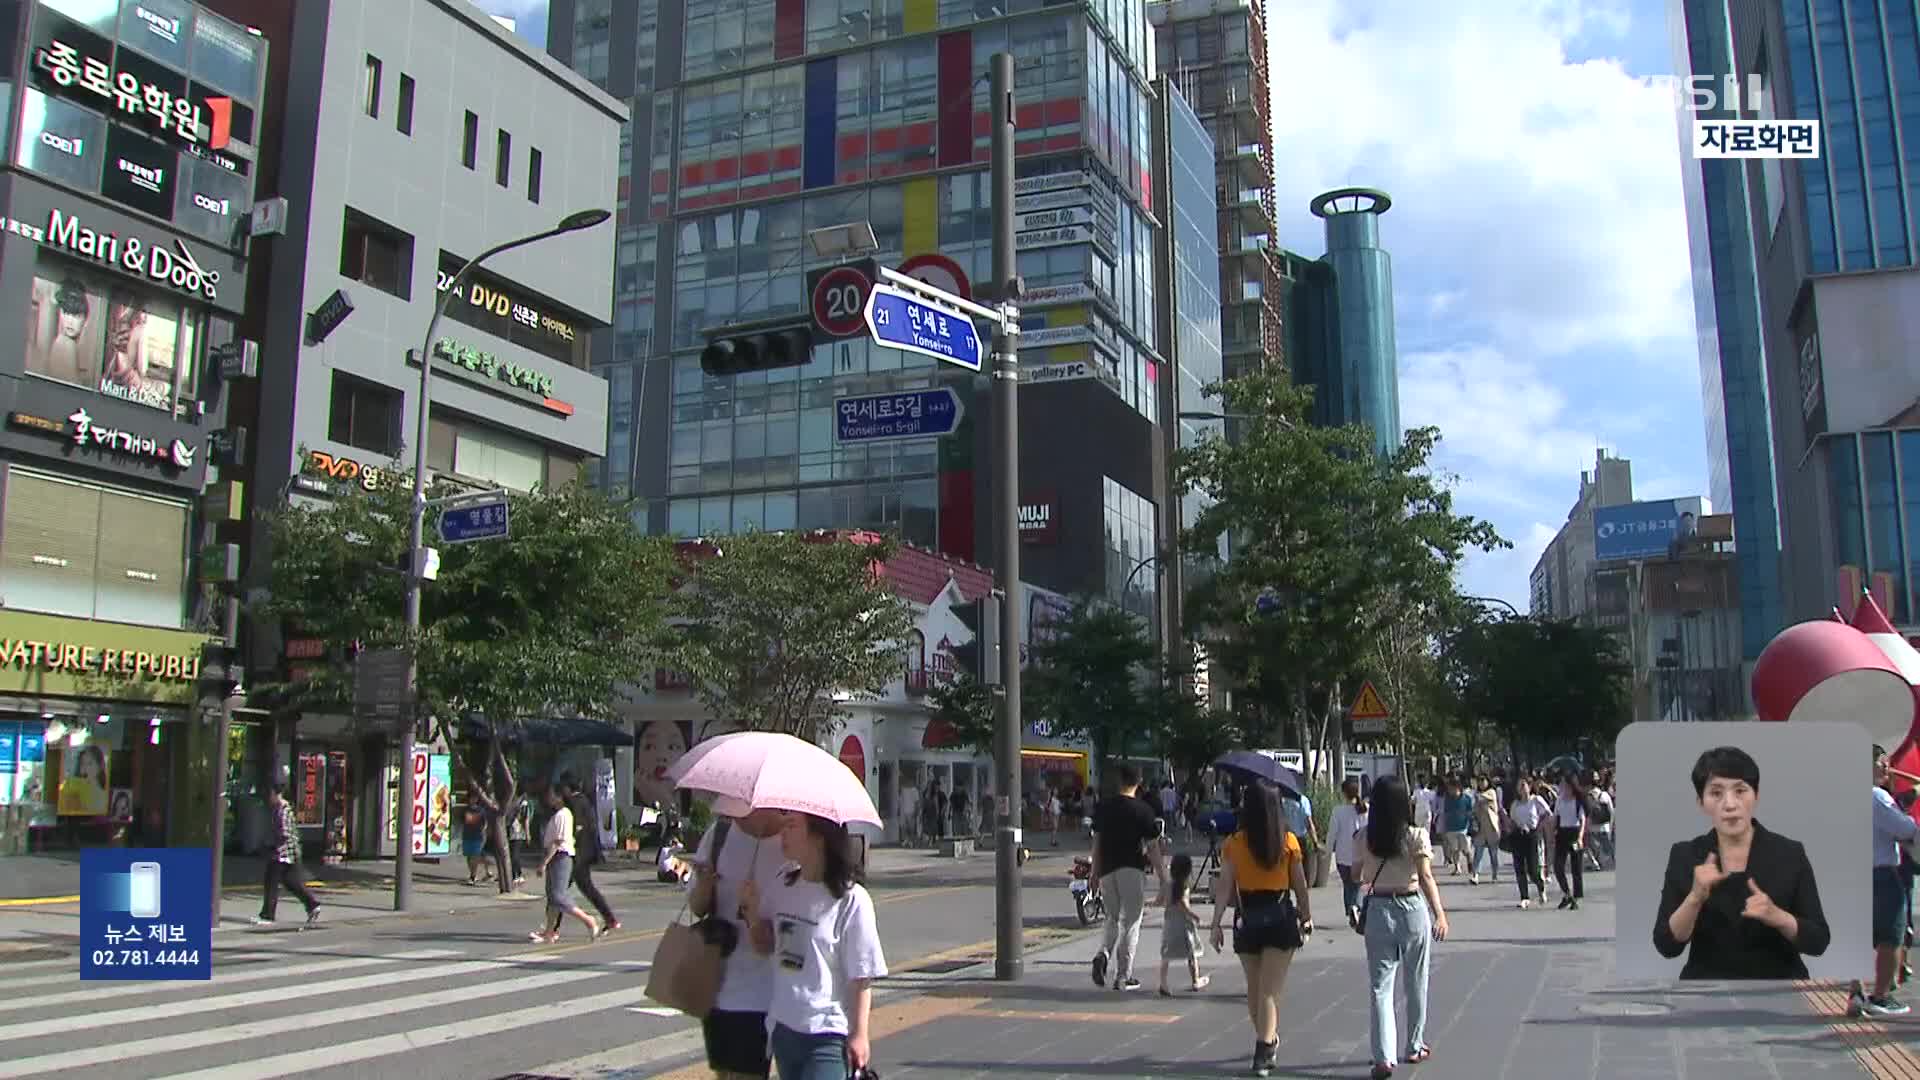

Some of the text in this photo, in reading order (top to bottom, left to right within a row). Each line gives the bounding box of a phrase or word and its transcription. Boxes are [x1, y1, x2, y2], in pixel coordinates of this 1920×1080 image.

[46, 38, 201, 142] 종로유학원
[47, 207, 118, 262] Mari
[122, 236, 146, 273] &
[469, 283, 511, 317] DVD
[825, 284, 860, 319] 20
[876, 308, 891, 325] 21
[906, 304, 951, 338] 연세로
[911, 331, 953, 356] Yonsei-ro
[1066, 363, 1085, 377] PC
[840, 395, 922, 424] 연세로5길
[841, 422, 893, 437] Yonsei-ro
[1016, 503, 1050, 522] MUJI
[0, 638, 200, 681] NATURE REPUBLI
[413, 753, 427, 826] DVD
